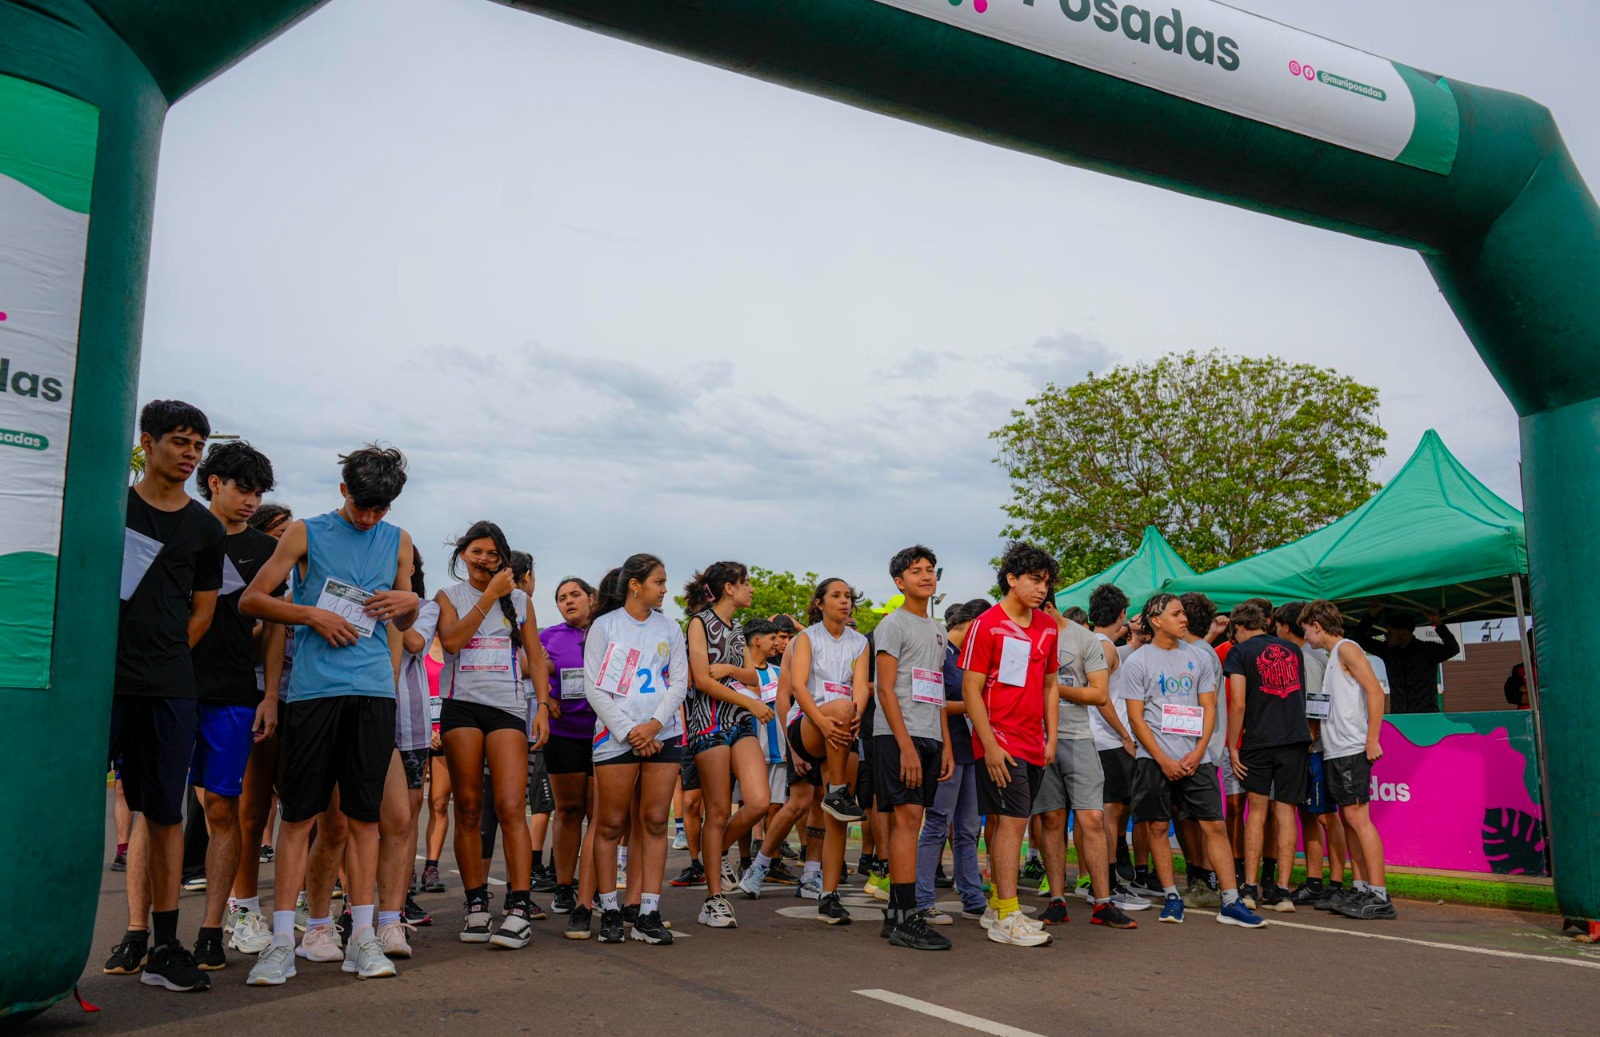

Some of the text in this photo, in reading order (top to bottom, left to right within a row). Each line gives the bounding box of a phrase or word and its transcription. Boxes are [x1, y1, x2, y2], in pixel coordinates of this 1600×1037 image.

[1023, 0, 1240, 71] osadas
[1321, 72, 1383, 98] @muniposadas
[636, 668, 656, 694] 2
